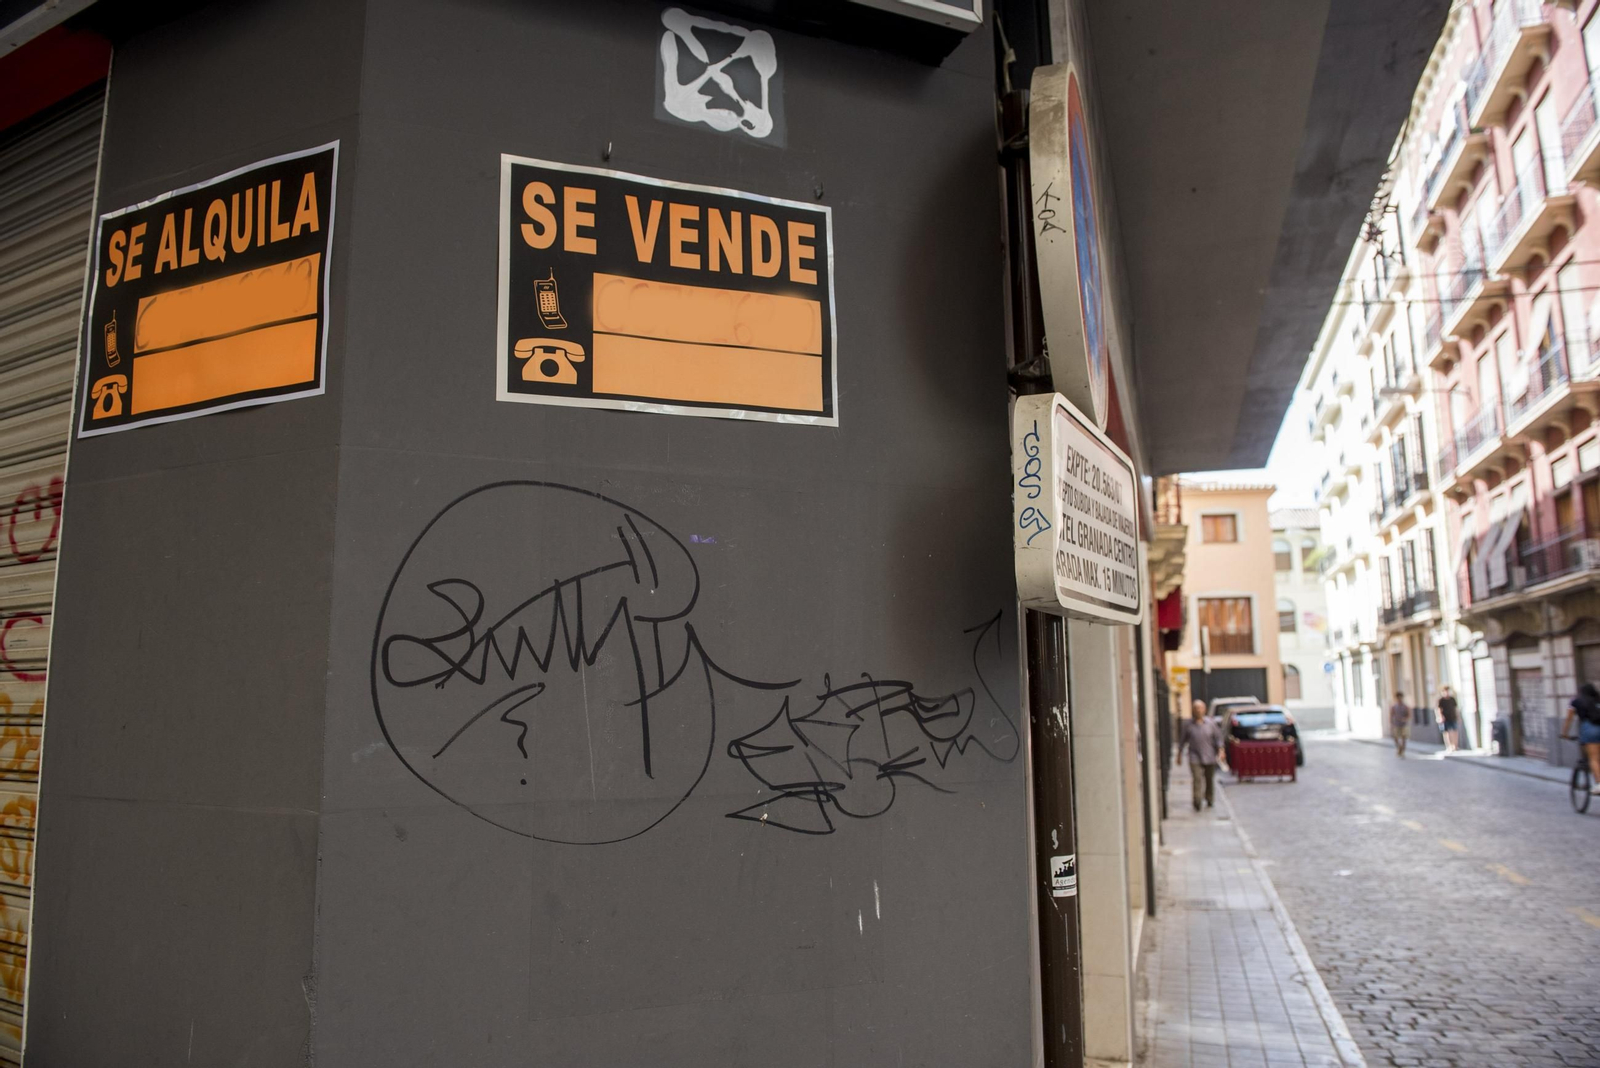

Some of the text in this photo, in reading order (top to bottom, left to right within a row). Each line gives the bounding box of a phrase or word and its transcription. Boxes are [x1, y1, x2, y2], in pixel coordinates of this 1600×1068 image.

[105, 171, 320, 288] SE ALQUILA
[520, 181, 818, 286] SE VENDE
[1066, 444, 1091, 487] EXPTE:
[1074, 488, 1092, 517] SUBIDA
[1059, 512, 1077, 546] TEL
[1077, 520, 1114, 560] GRANADA
[1113, 537, 1136, 570] CENTRO
[1055, 549, 1084, 584] ARADA
[1082, 558, 1102, 590] MAX.
[1102, 566, 1112, 592] 15
